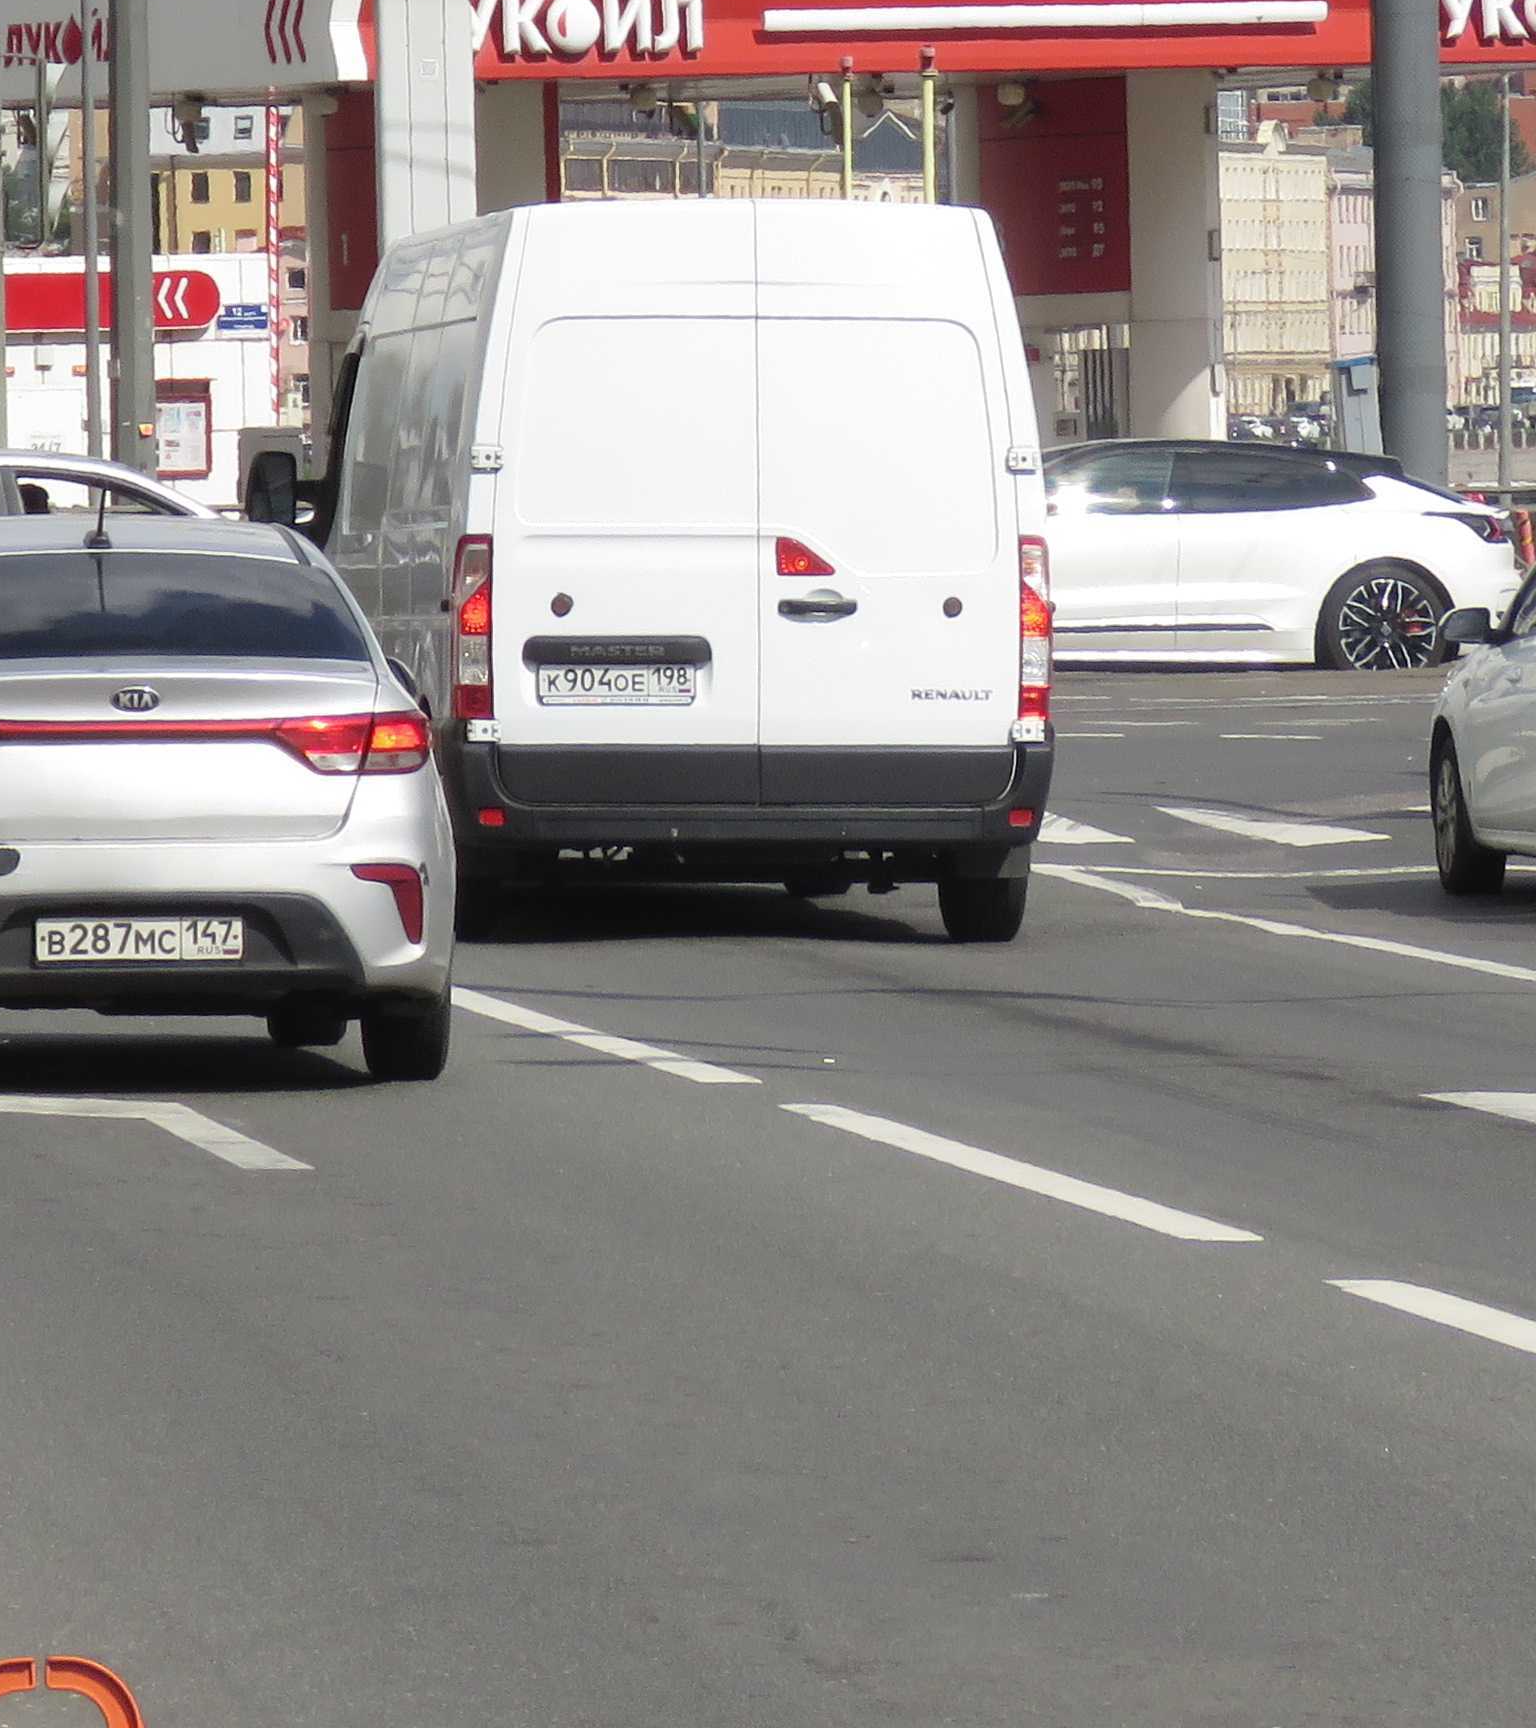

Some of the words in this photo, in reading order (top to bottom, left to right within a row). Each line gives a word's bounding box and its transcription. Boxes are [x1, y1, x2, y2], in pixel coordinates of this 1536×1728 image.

[570, 643, 666, 657] MASTER
[651, 666, 689, 686] 198
[118, 692, 154, 708] KIA
[910, 688, 993, 701] RENAULT
[185, 919, 233, 946] 147
[197, 945, 221, 955] RUS
